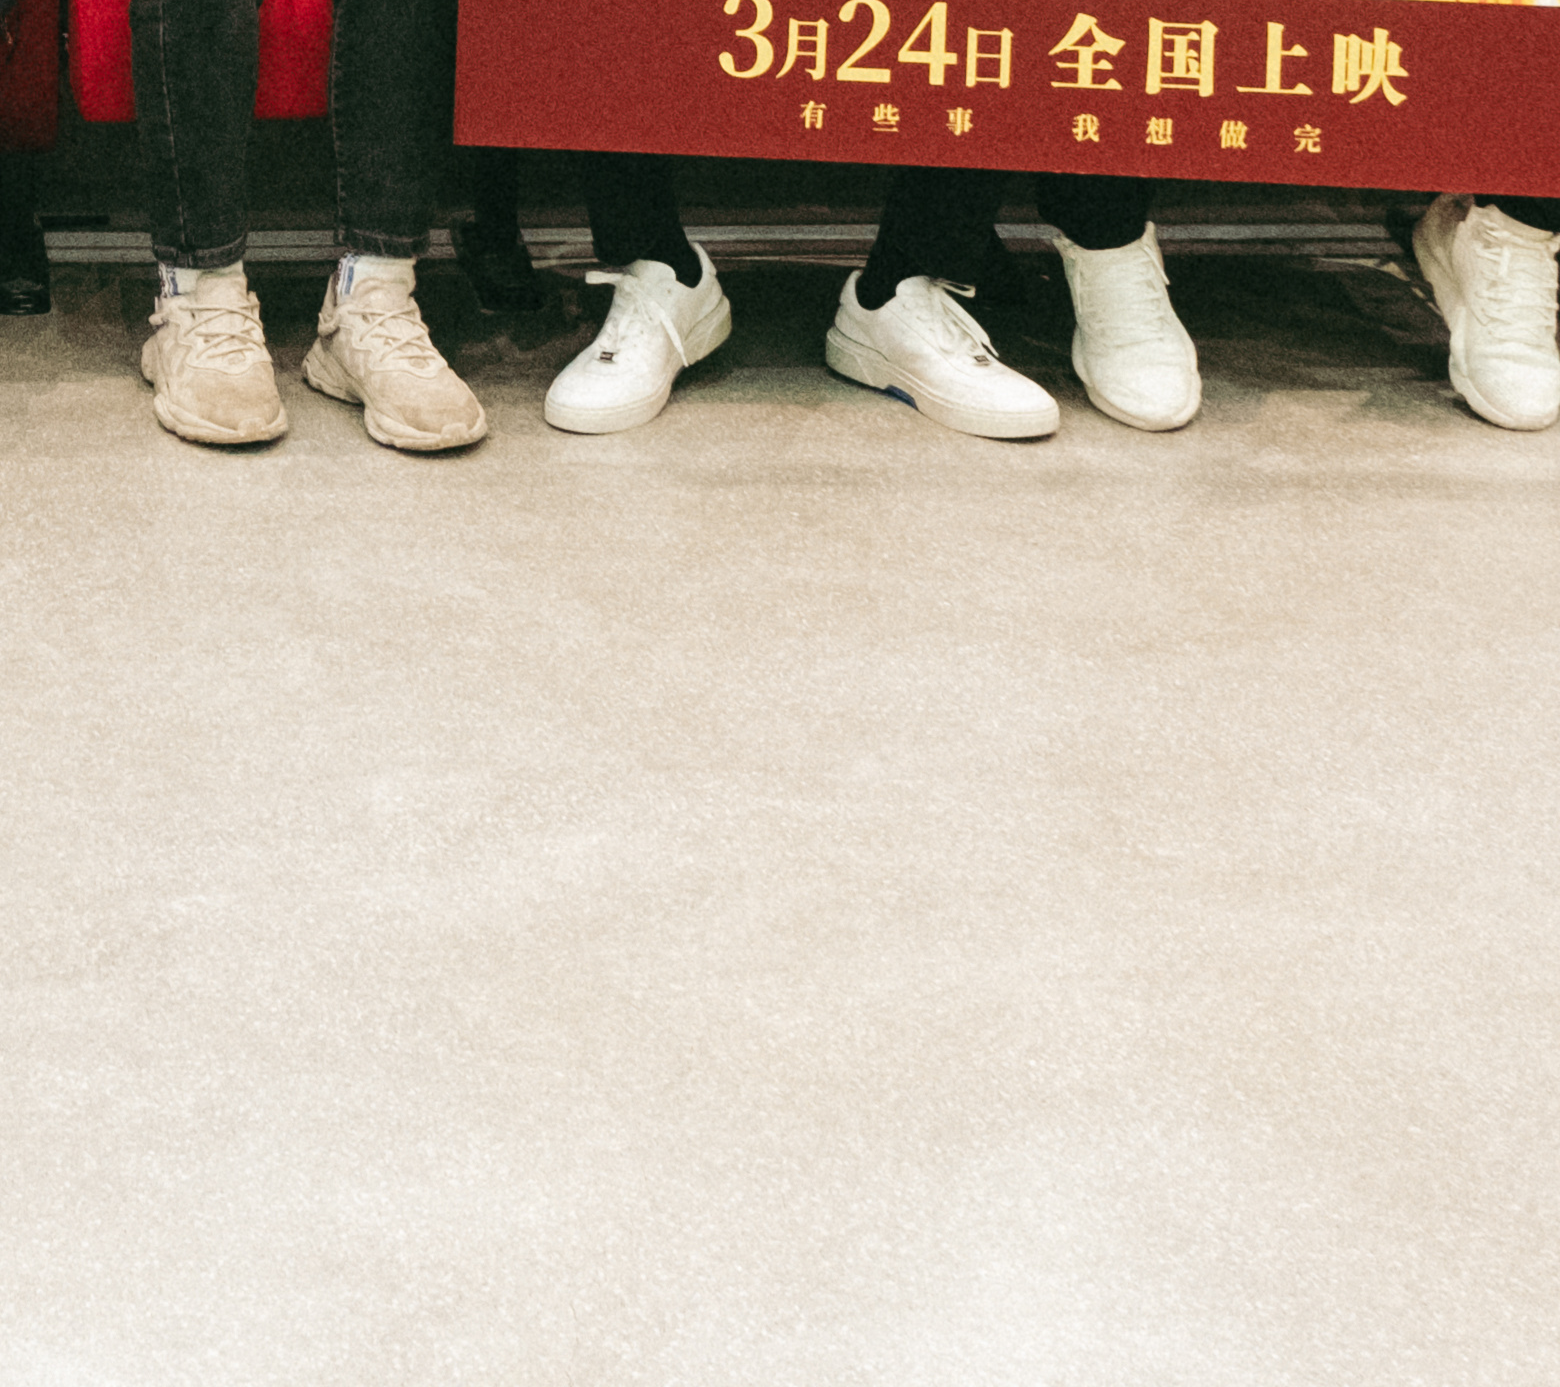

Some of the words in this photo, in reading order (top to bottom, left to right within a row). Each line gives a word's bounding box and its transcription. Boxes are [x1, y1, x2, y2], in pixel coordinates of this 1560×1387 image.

[1047, 12, 1410, 107] 全国上映
[799, 99, 975, 138] 有些事
[1070, 112, 1323, 155] 我想做完
